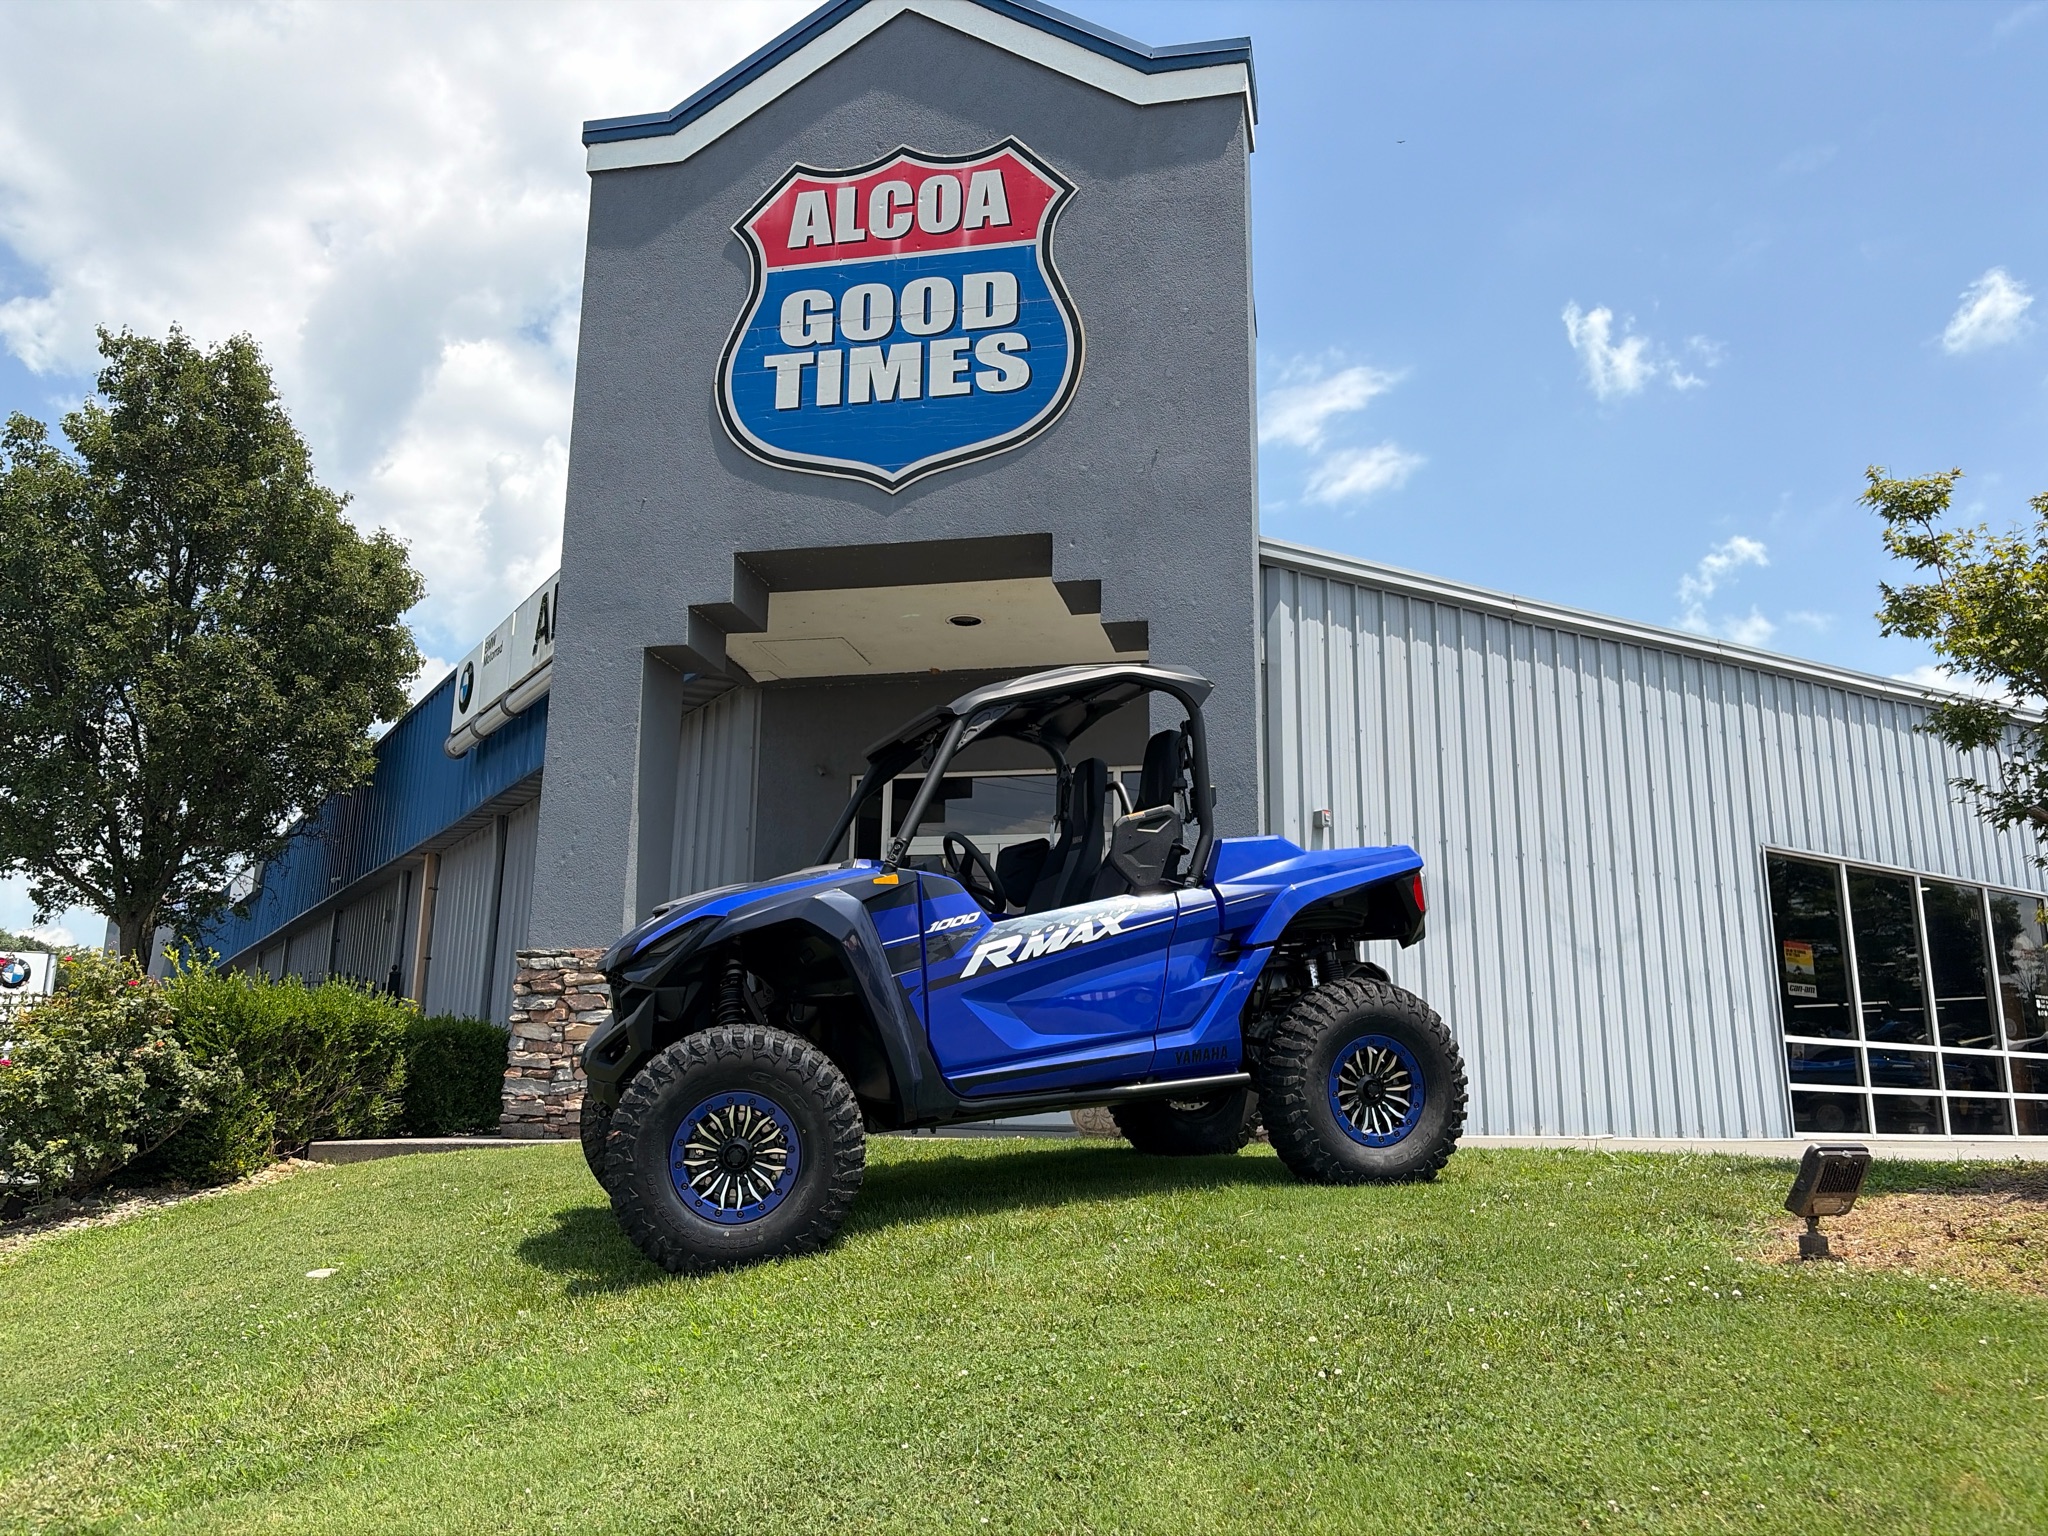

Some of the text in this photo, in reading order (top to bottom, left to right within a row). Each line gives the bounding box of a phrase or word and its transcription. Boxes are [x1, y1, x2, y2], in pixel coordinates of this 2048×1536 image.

[787, 169, 1011, 248] ALCOA
[779, 271, 1019, 347] GOOD
[764, 332, 1031, 410] TIMES
[483, 639, 504, 668] Motorrad
[484, 633, 497, 654] BMW
[924, 911, 982, 934] 1000
[959, 910, 1136, 979] RMAX
[1175, 1045, 1228, 1065] YAMAHA
